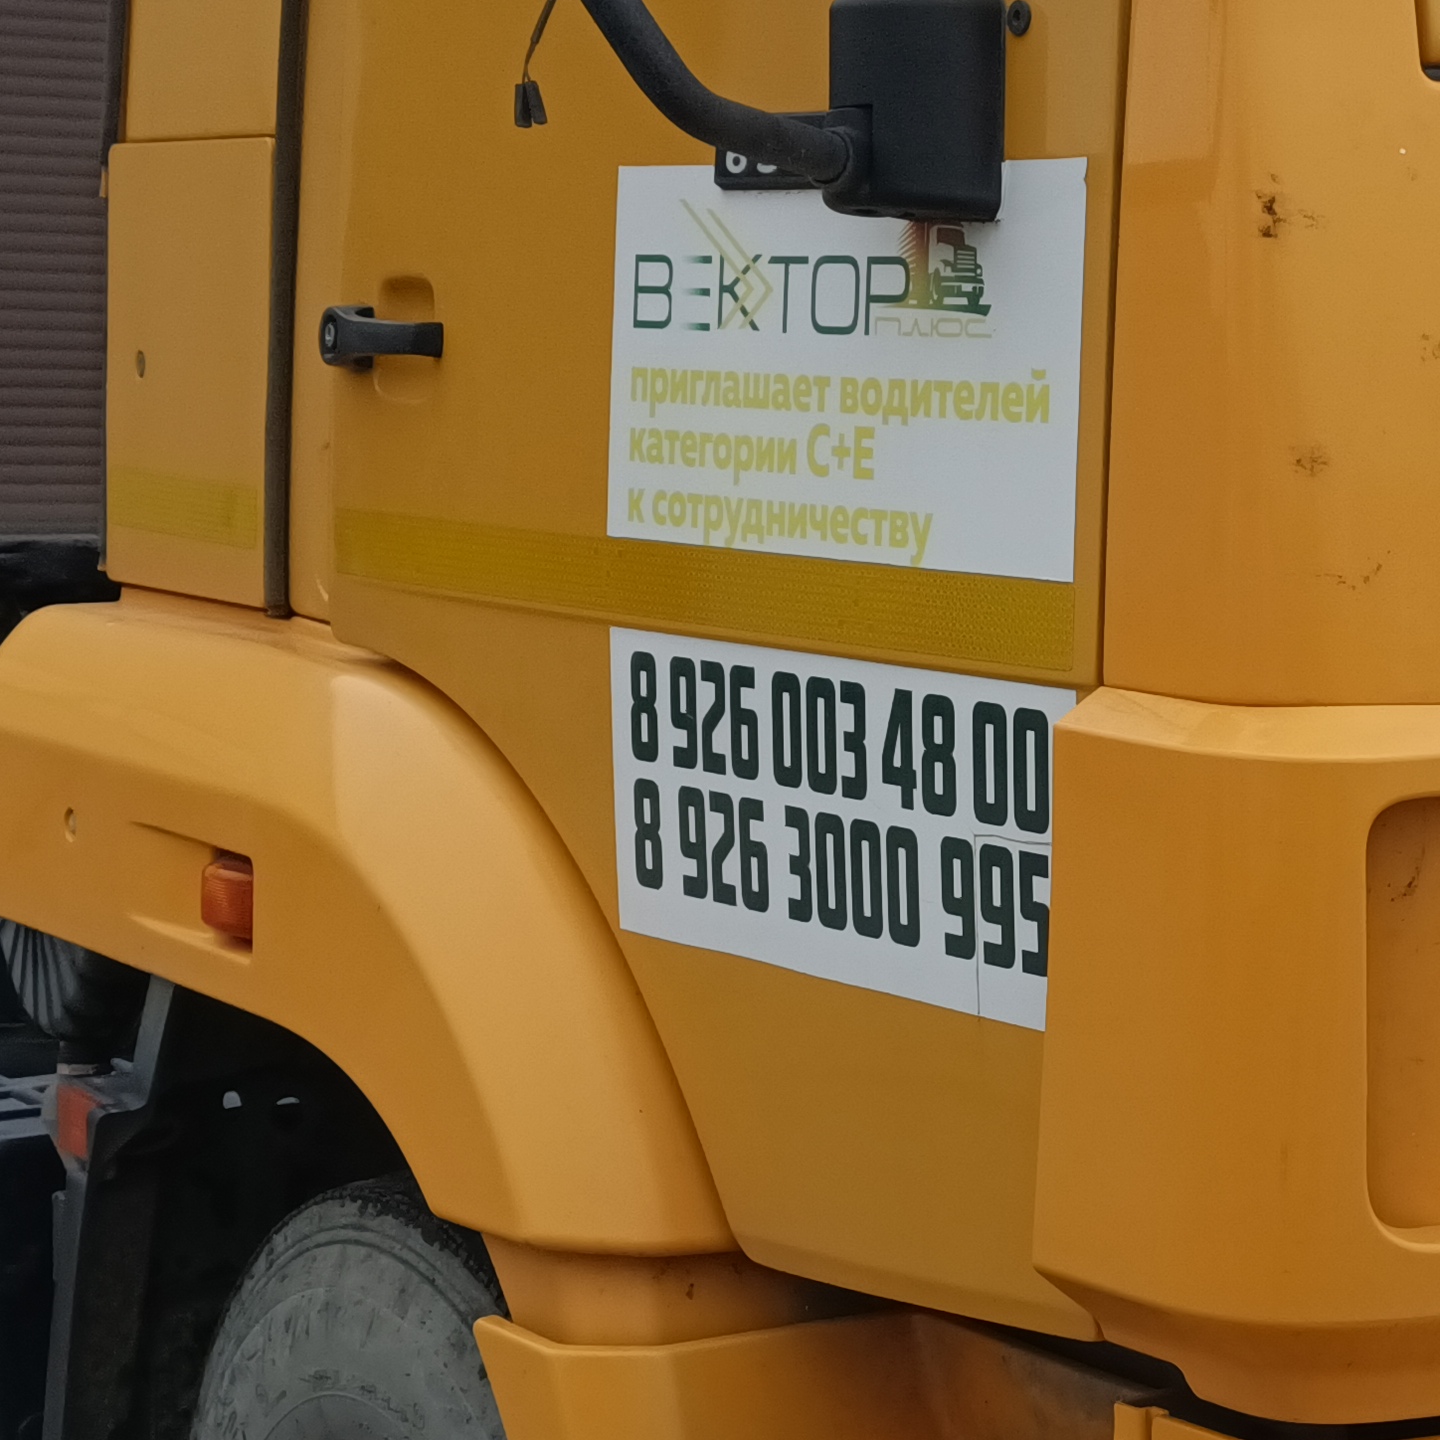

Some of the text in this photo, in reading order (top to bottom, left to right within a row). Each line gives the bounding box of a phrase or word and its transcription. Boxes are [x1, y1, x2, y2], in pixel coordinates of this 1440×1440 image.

[632, 253, 911, 336] ВЕКТОР
[874, 316, 992, 339] ПЛЮС
[629, 365, 1050, 426] приглашает водителей
[628, 423, 875, 485] категории С+Е
[627, 487, 933, 566] к сотрудничеству
[630, 650, 1050, 834] 8 926 003 48 00
[633, 777, 1049, 978] 8 926 3000 995
